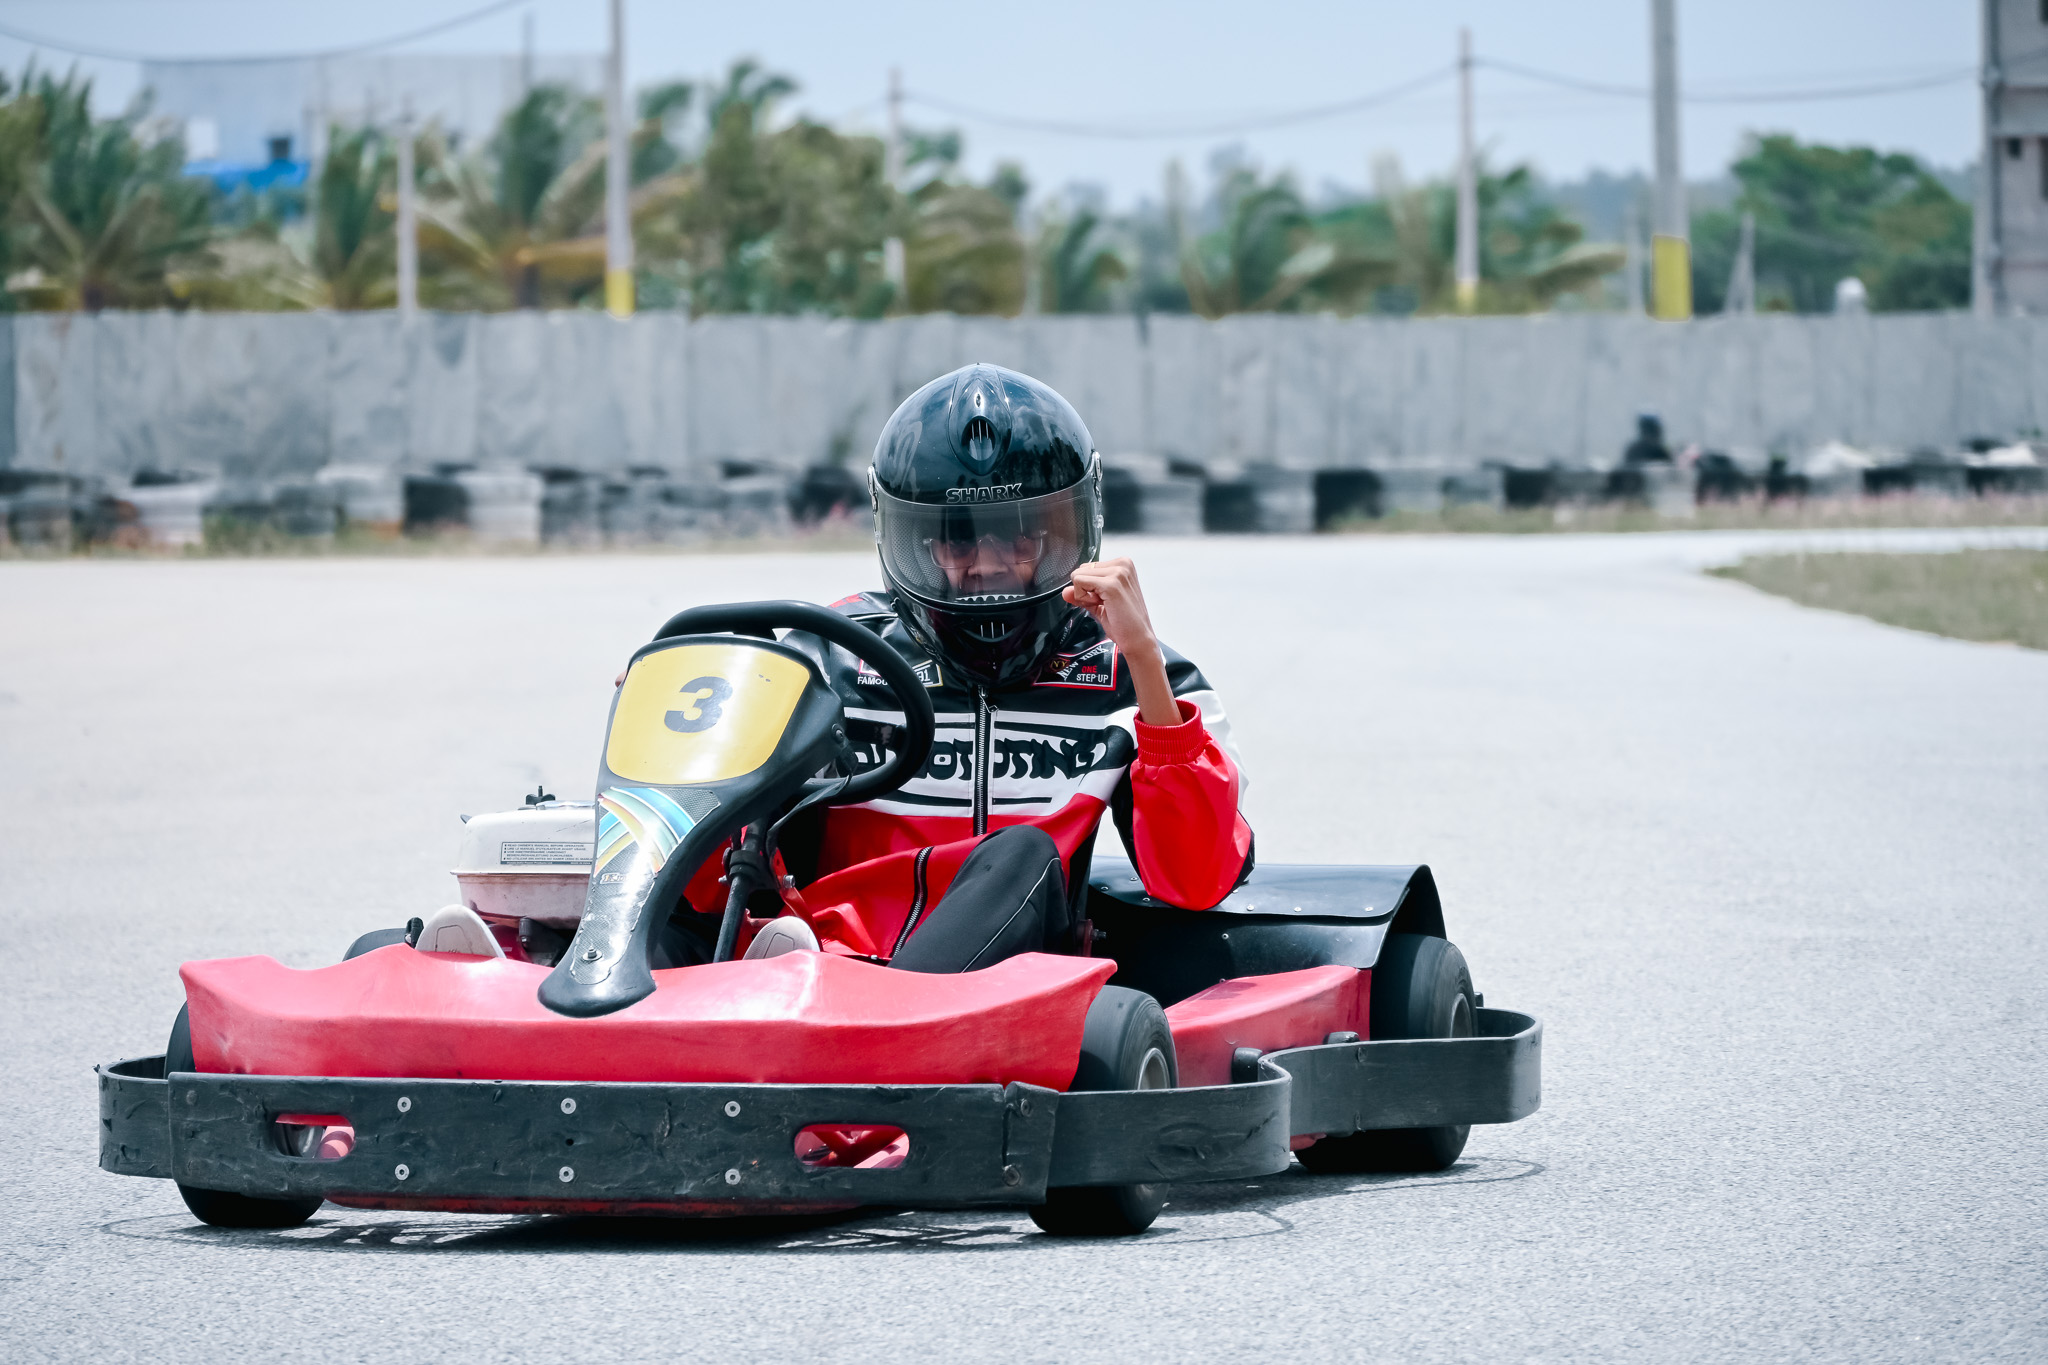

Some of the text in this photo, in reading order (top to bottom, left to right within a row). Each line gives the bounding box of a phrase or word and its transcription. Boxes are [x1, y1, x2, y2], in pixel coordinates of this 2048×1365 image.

[945, 482, 1023, 504] SHARK
[1057, 645, 1109, 682] NEW YORK
[1081, 665, 1098, 674] ONE
[1076, 673, 1109, 683] STEP UP
[664, 676, 734, 733] 3
